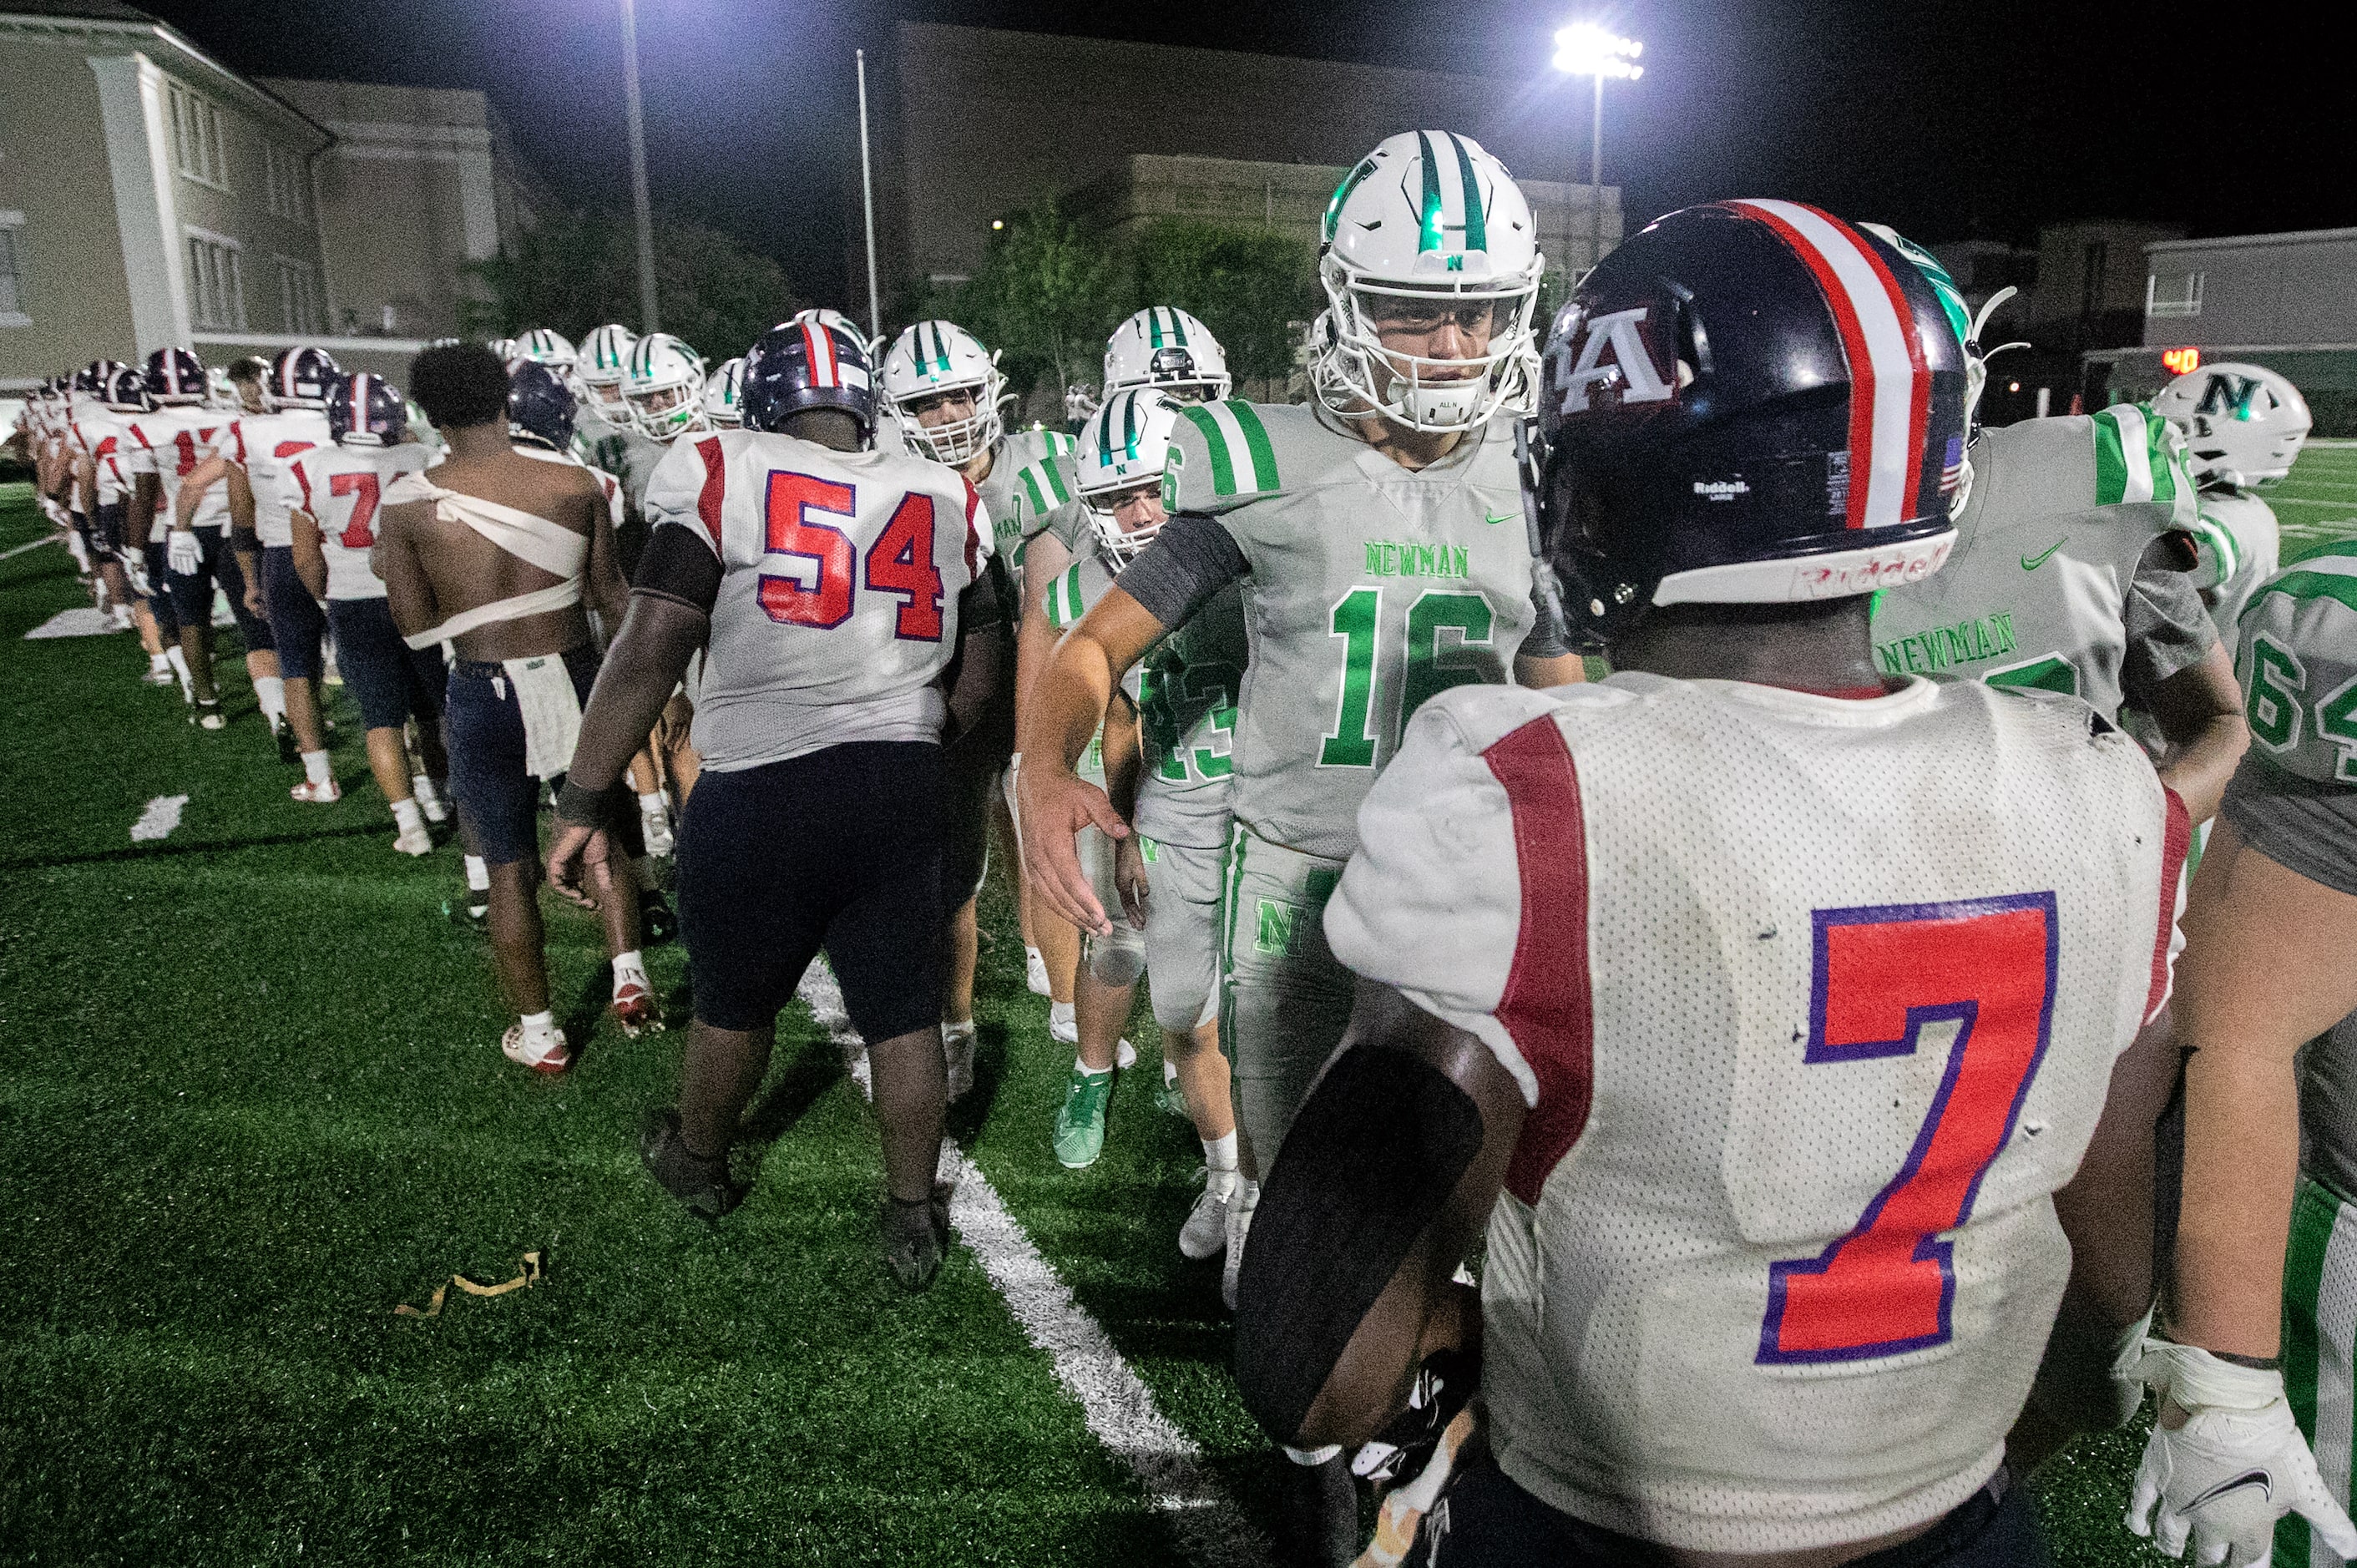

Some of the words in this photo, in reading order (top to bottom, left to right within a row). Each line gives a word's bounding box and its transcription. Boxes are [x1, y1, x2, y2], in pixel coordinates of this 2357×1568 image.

[1447, 255, 1464, 271] N
[2162, 347, 2200, 375] 40
[2193, 372, 2263, 422] N
[1115, 464, 1127, 476] N
[1693, 480, 1747, 494] Riddell
[330, 472, 380, 548] 7
[756, 469, 945, 642] 54
[1364, 541, 1469, 579] NEWMAN
[1788, 542, 1950, 600] Riddell
[1874, 609, 2018, 673] NEWMAN
[1315, 585, 1498, 770] 16
[1254, 899, 1307, 959] N
[1754, 890, 2060, 1365] 7
